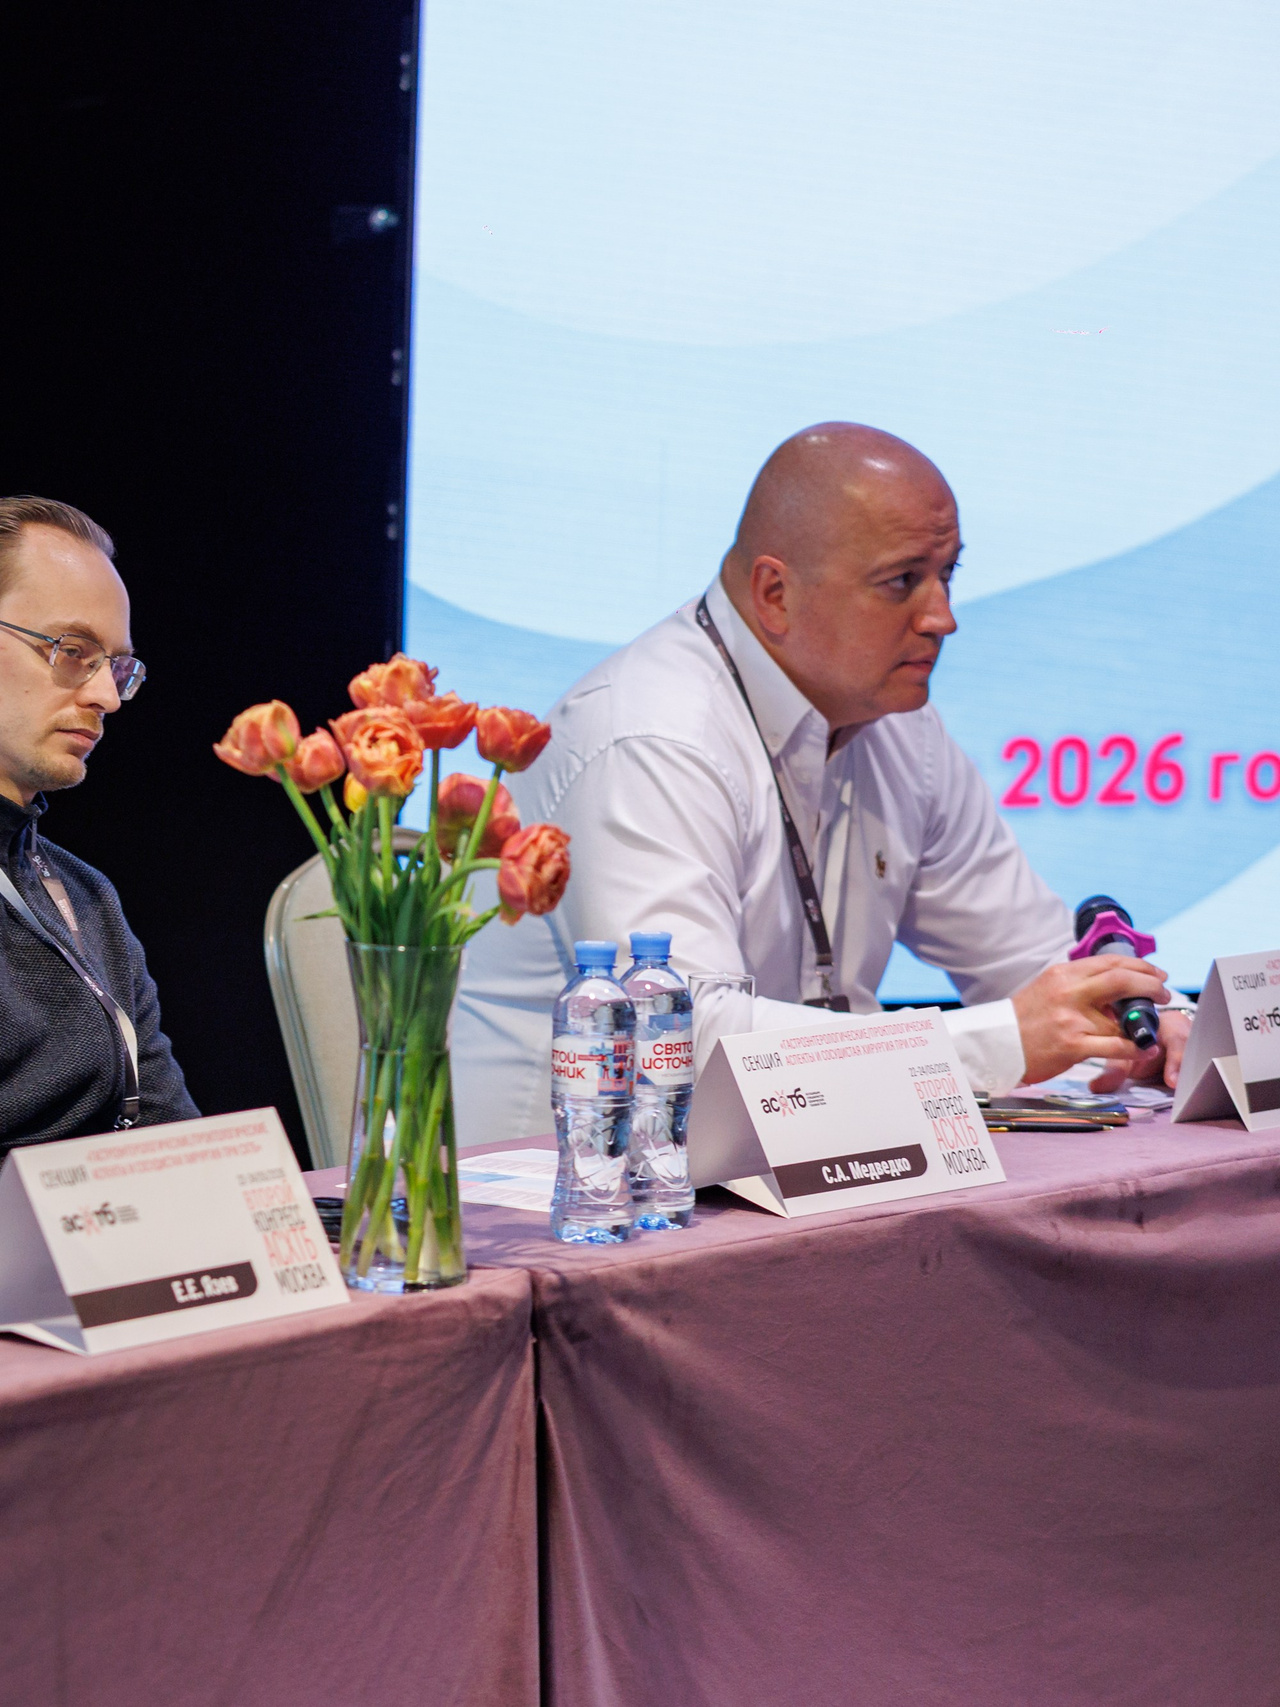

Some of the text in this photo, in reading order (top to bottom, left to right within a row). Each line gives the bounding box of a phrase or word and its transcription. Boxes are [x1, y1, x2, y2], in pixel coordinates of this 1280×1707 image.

[1001, 733, 1185, 808] 2026
[1232, 971, 1267, 991] СЕКЦИЯ
[742, 1052, 783, 1072] СЕКЦИЯ
[914, 1073, 959, 1100] ВТОРОЙ
[922, 1095, 968, 1119] КОНГРЕСС
[932, 1114, 979, 1151] АСХТБ
[821, 1158, 912, 1184] С.А. Медведко
[942, 1147, 990, 1176] МОСКВА
